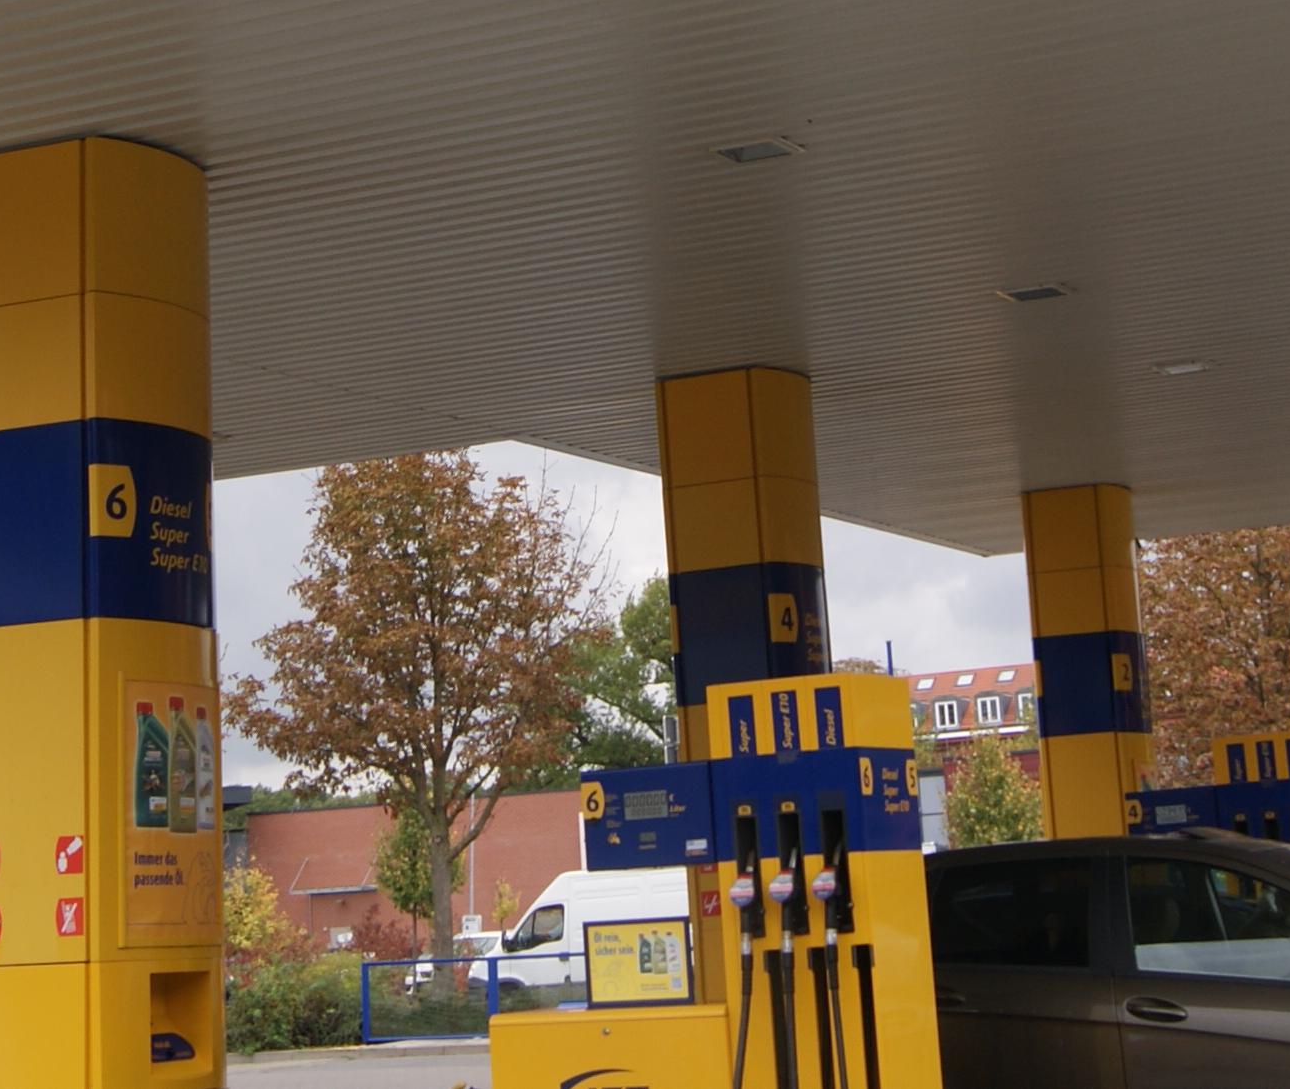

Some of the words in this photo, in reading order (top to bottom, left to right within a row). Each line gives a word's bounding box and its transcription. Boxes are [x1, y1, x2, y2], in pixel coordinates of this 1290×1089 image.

[106, 483, 127, 520] 6
[150, 495, 193, 519] Diesel
[150, 522, 189, 547] Super
[150, 547, 189, 573] Super
[781, 607, 794, 631] 4
[1121, 663, 1130, 681] 2
[739, 719, 751, 753] Super
[782, 715, 794, 749] Super
[824, 709, 836, 746] Diesel
[864, 765, 870, 788] 6
[910, 766, 916, 788] 5
[586, 790, 599, 812] 6
[1129, 805, 1138, 822] 4
[134, 851, 163, 866] Immer
[164, 851, 178, 866] das
[134, 871, 174, 889] passende
